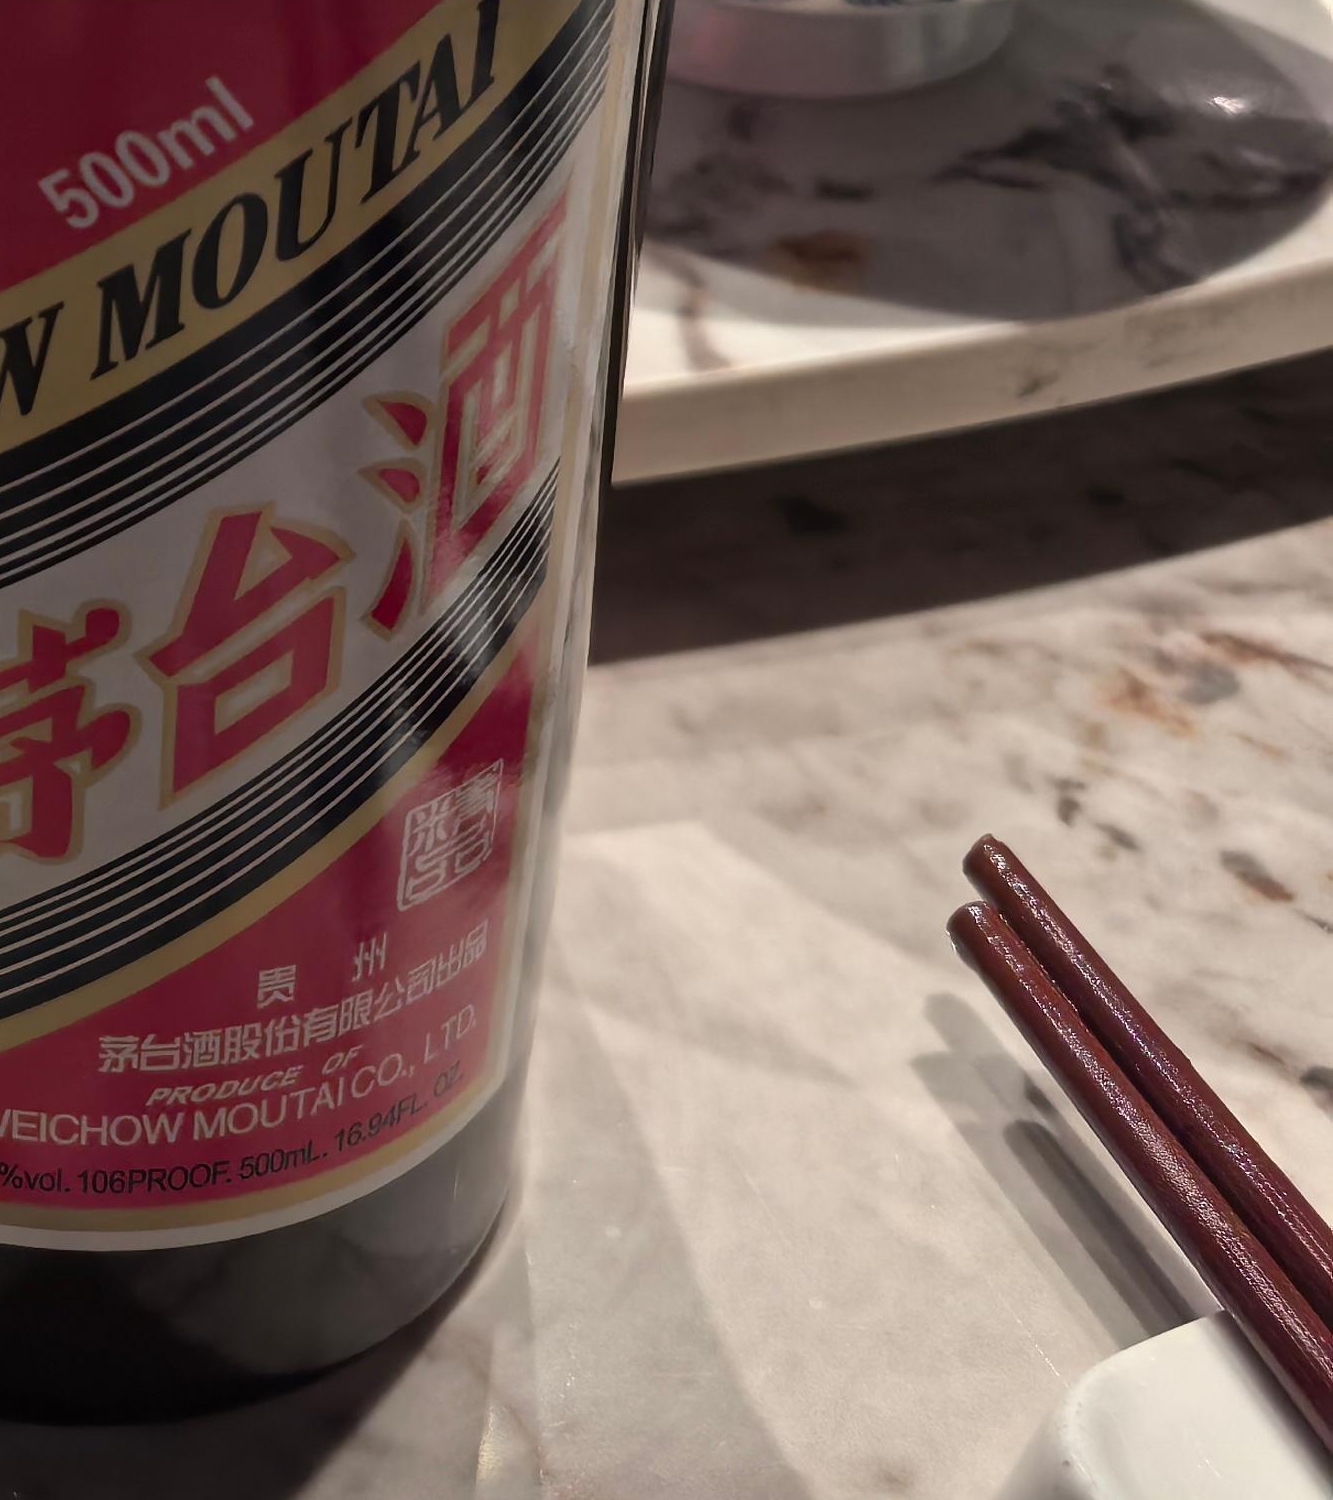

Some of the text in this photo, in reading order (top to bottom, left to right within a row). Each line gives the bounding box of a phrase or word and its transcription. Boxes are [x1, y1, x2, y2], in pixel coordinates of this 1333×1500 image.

[38, 76, 254, 229] 500ml
[98, 919, 489, 1073] 茅台酒股份有限公司出品
[146, 1045, 363, 1106] PRODUCE OF
[193, 1077, 344, 1141] MOUTAI
